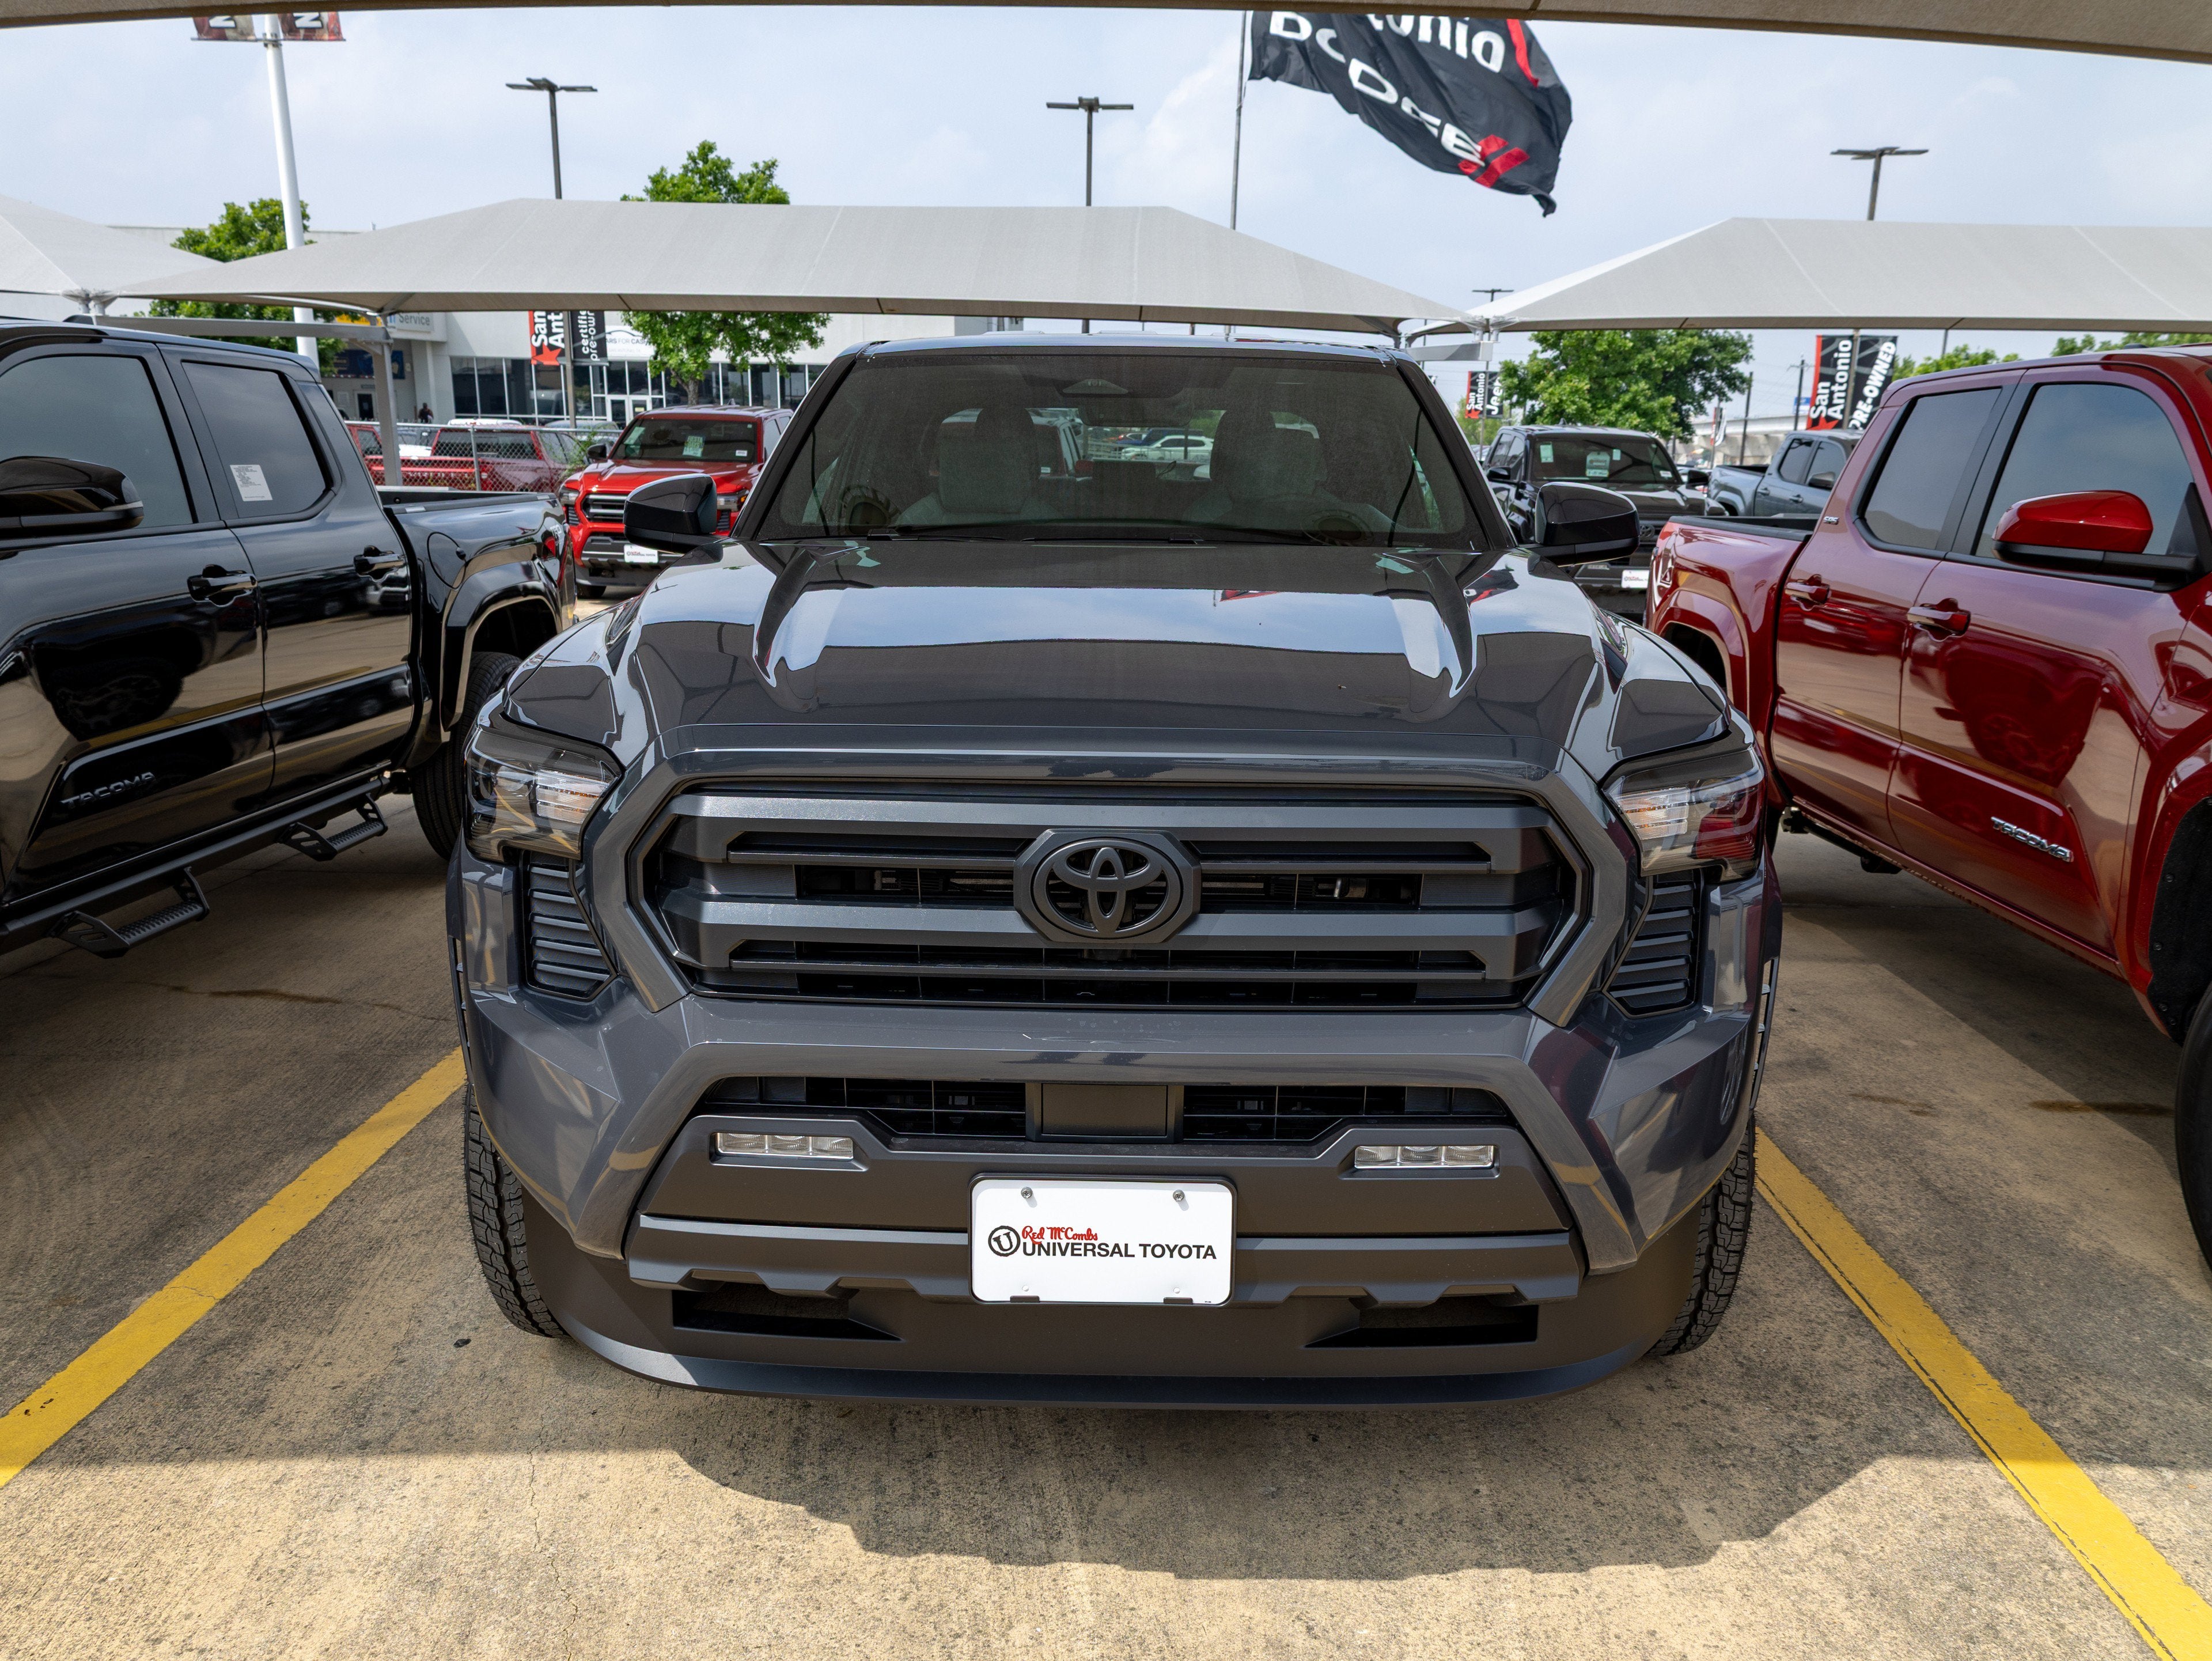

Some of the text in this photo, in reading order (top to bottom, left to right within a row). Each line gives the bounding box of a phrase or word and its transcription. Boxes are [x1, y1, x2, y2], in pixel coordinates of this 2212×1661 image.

[399, 313, 430, 326] Service
[531, 311, 547, 347] San
[1475, 373, 1486, 411] Antonio
[1827, 339, 1853, 420] Antonio
[1848, 341, 1896, 431] PRE-OWNED
[1466, 392, 1476, 410] San
[1809, 381, 1831, 419] San
[60, 771, 156, 809] TACOMA
[1991, 816, 2074, 862] TACOMA
[1021, 1225, 1045, 1244] Red
[1022, 1242, 1217, 1260] UNIVERSAL TOYOTA
